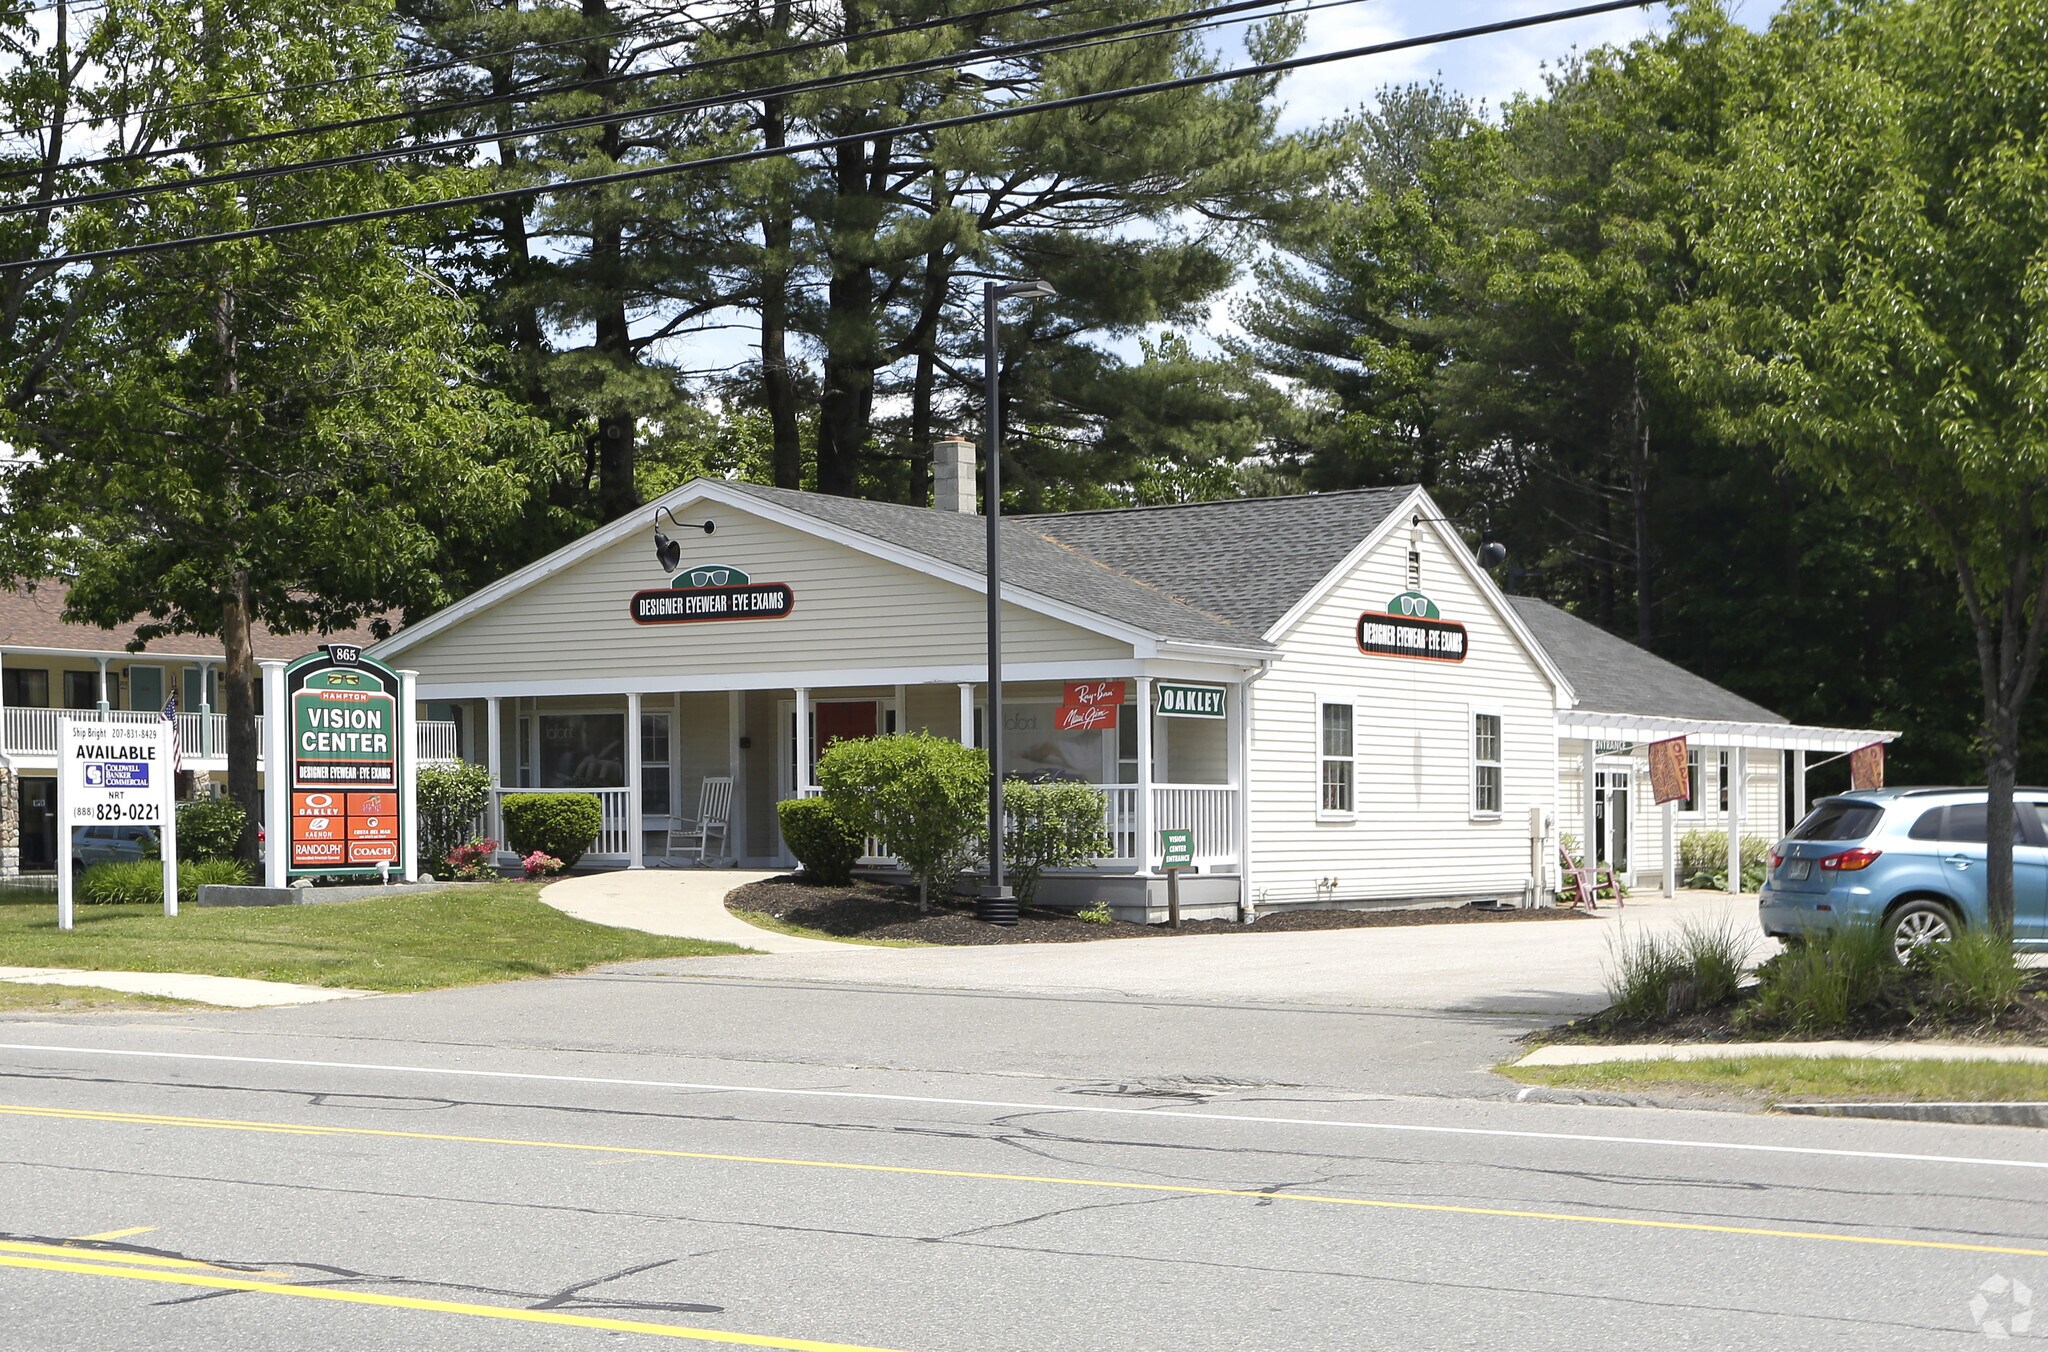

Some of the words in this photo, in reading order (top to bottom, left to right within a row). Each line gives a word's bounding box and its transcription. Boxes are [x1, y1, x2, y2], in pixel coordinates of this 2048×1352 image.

[640, 597, 684, 616] DESIGNER
[686, 595, 727, 614] EYEWEAR
[732, 594, 748, 611] EYE
[751, 591, 784, 610] EXAMS
[1363, 622, 1396, 646] DESIGNER
[1396, 626, 1426, 649] EYEWEAR
[1428, 630, 1440, 650] EYE
[1441, 630, 1462, 653] EXAMS
[336, 648, 356, 660] 865
[1164, 690, 1220, 712] OAKLEY
[307, 708, 381, 729] VISION
[73, 727, 86, 740] Ship
[88, 728, 106, 740] Bright
[112, 729, 157, 739] 207-831-8429
[301, 731, 388, 753] CENTER
[1596, 740, 1625, 752] ENTRANCE
[76, 745, 156, 760] AVAILABLE
[300, 766, 329, 778] DESIGNER
[330, 766, 356, 779] EYEWEAR
[360, 767, 370, 779] EYE
[371, 767, 391, 779] EXAMS
[74, 807, 94, 818] (888)
[97, 804, 159, 820] 829-0221
[296, 844, 341, 854] RANDOLPH
[353, 848, 392, 856] COACH
